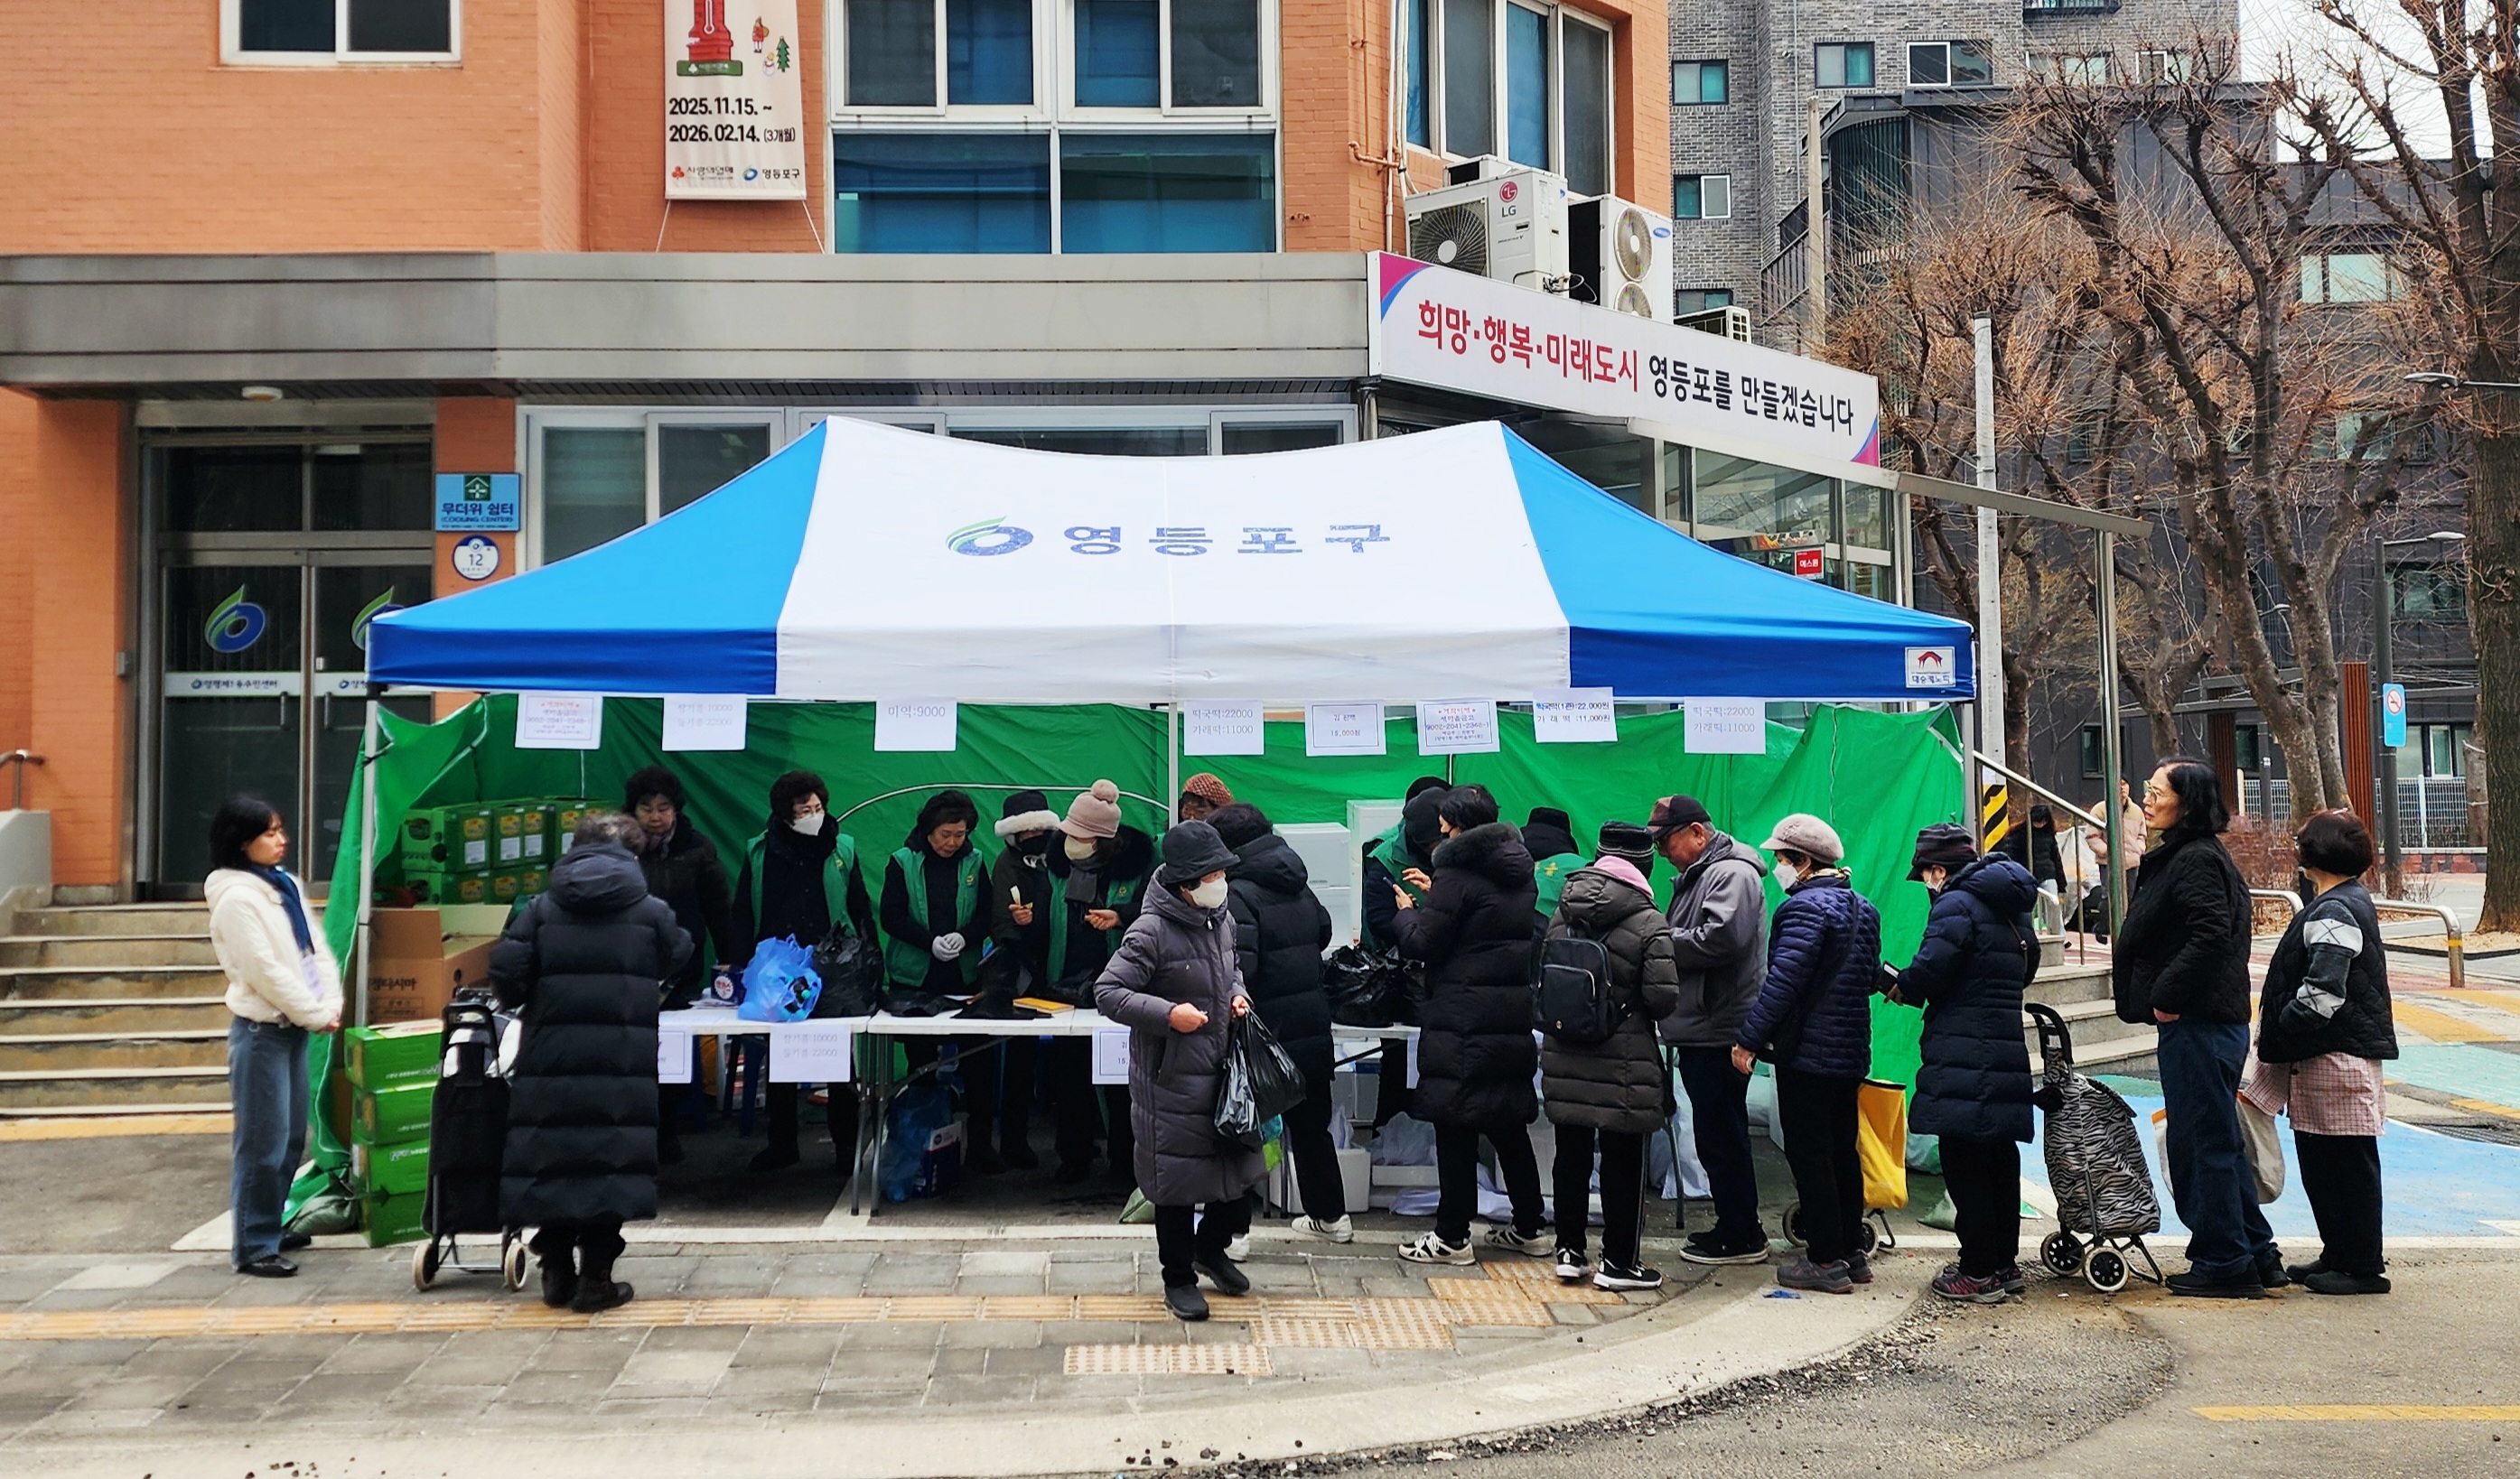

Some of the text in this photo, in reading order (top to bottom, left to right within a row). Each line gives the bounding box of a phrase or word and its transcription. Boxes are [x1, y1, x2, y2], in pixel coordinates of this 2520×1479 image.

[668, 97, 758, 116] 2025.11.15.
[668, 124, 796, 143] 2026.02.14. (3개월)
[762, 168, 800, 180] 영등포구
[1501, 205, 1517, 218] LG
[1648, 354, 1733, 412] 영등포를
[1741, 376, 1854, 436] 만들겠습니다
[442, 502, 514, 516] 무더위 쉼터
[1063, 523, 1391, 557] 영등포구
[469, 553, 483, 567] 12
[888, 705, 946, 719] 미역:9000
[1192, 709, 1254, 720] 떡국떡:22000
[1693, 706, 1755, 717] 떡국떡:22000
[1192, 725, 1254, 735] 가래떡:11000
[1693, 722, 1755, 733] 가래떡:11000
